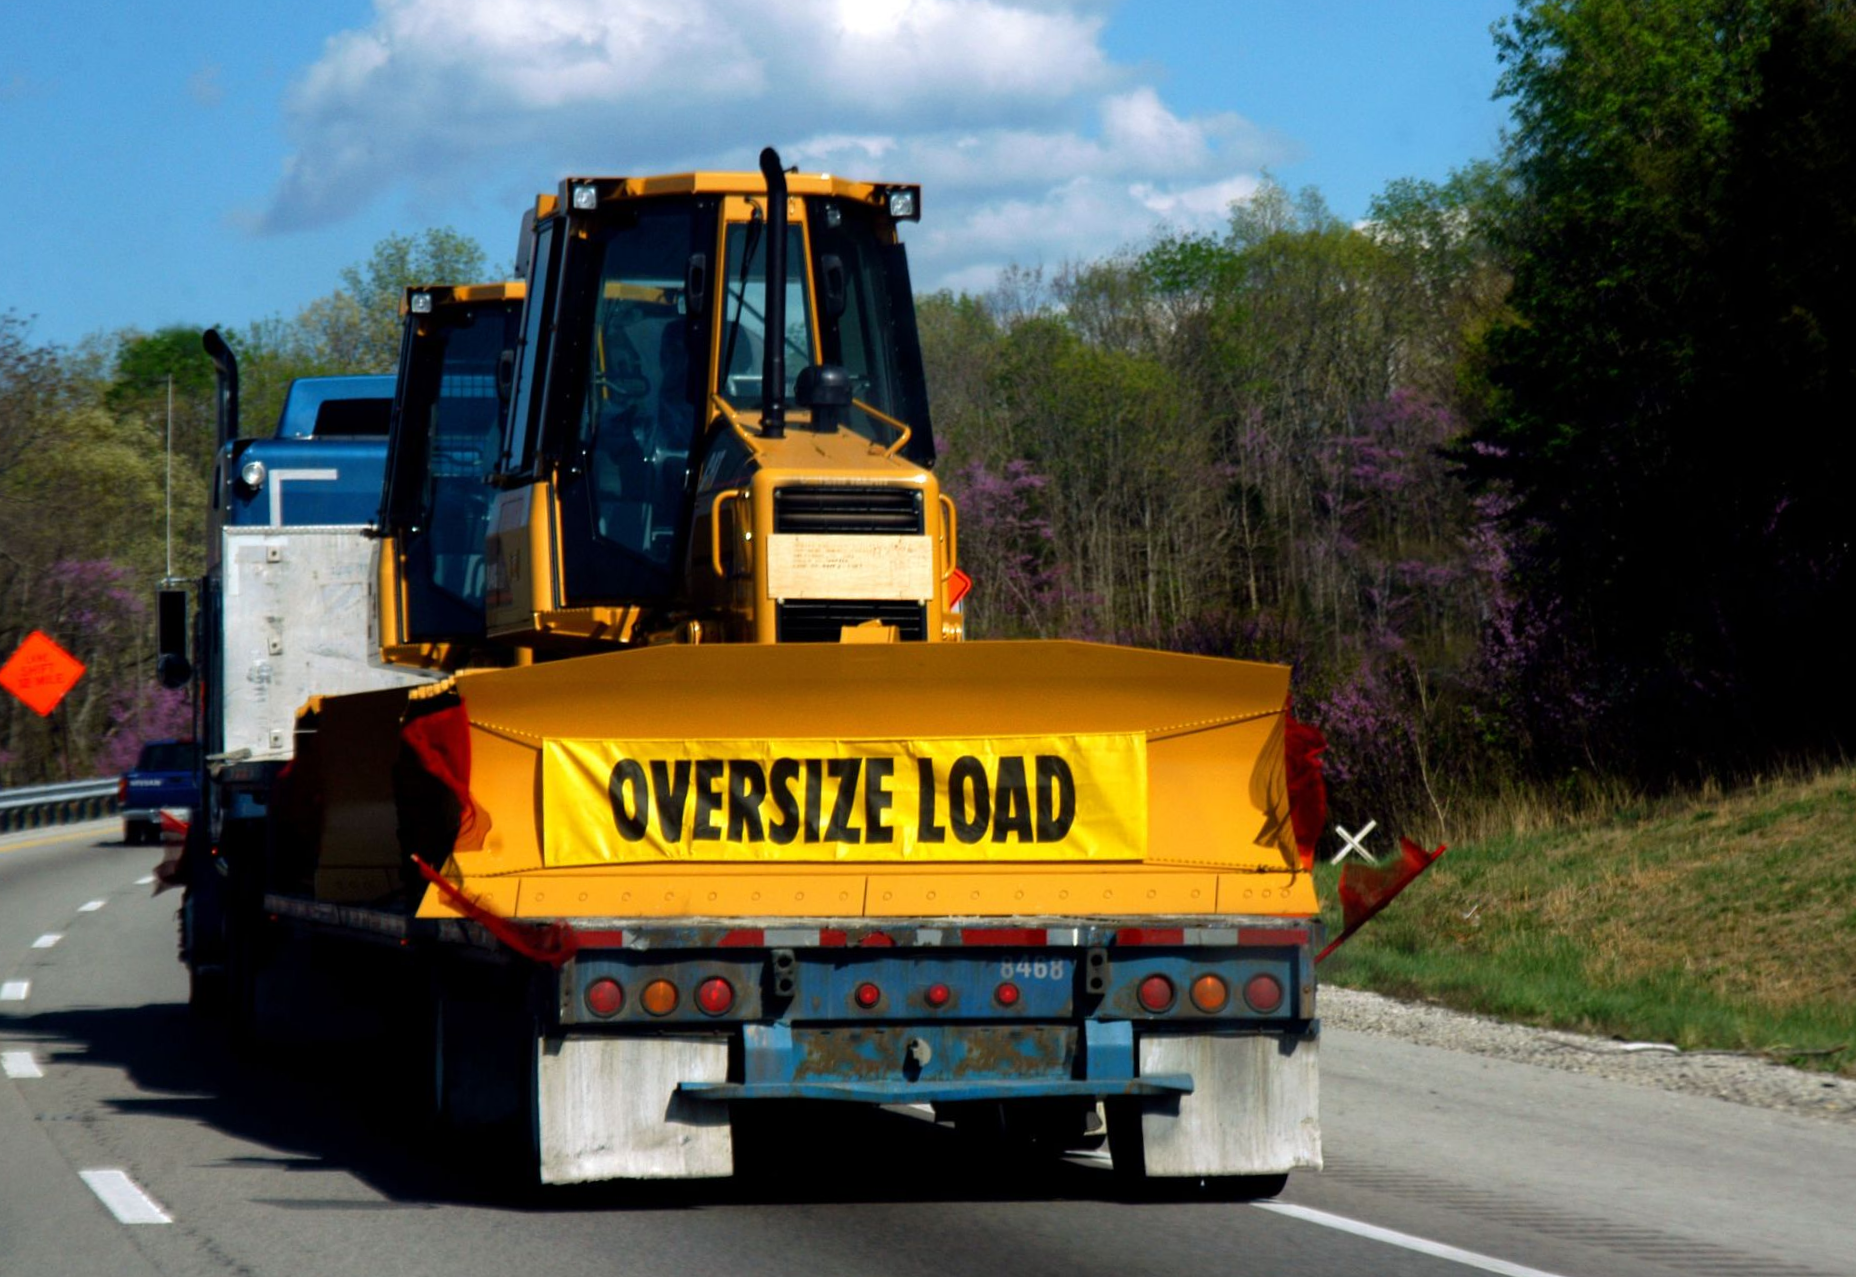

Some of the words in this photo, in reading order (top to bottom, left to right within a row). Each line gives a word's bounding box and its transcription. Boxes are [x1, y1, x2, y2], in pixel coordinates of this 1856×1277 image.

[608, 757, 894, 845] OVERSIZE
[917, 755, 1076, 844] LOAD
[1000, 955, 1064, 980] 8468
